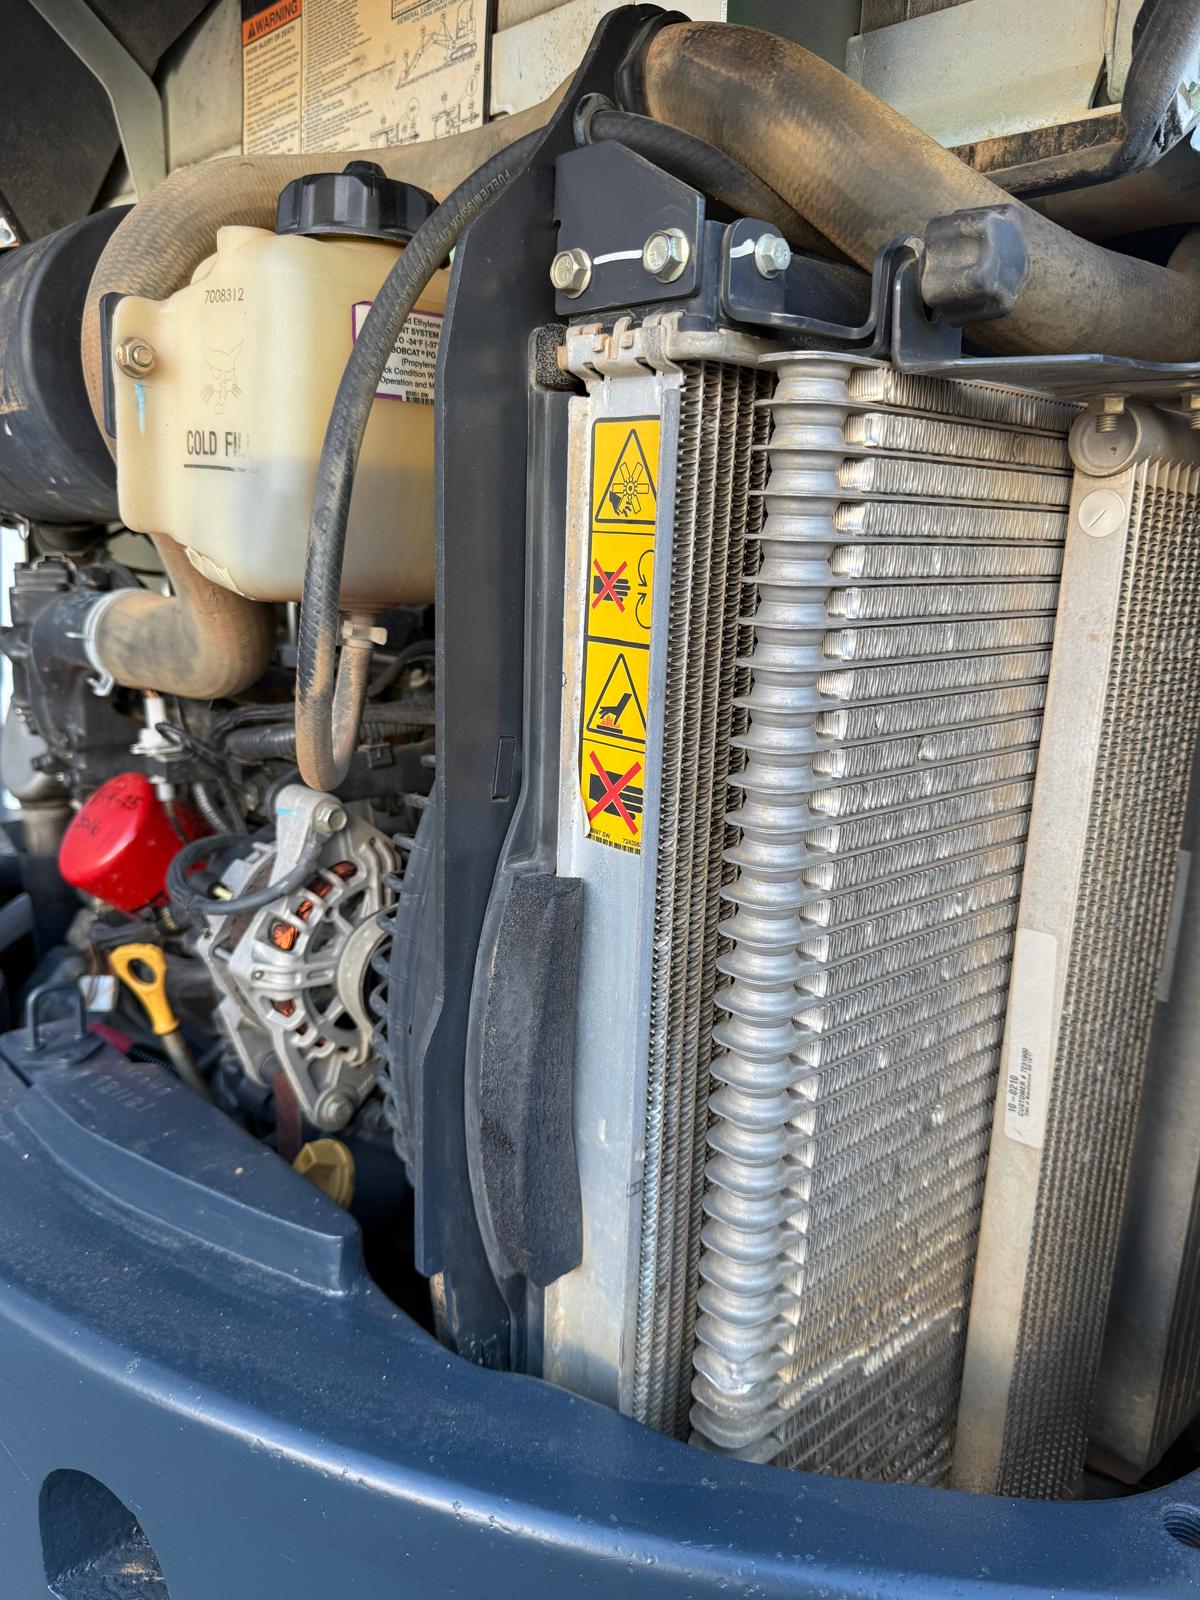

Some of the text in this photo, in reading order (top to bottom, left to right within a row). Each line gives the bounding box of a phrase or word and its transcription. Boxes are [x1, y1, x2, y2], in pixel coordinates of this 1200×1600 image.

[255, 0, 297, 33] WARNING
[205, 288, 244, 304] 7008312
[413, 318, 441, 329] Ethylene
[411, 328, 439, 339] SYSTEM
[394, 367, 426, 378] Condition
[380, 376, 413, 387] Operation
[187, 430, 217, 456] COLD
